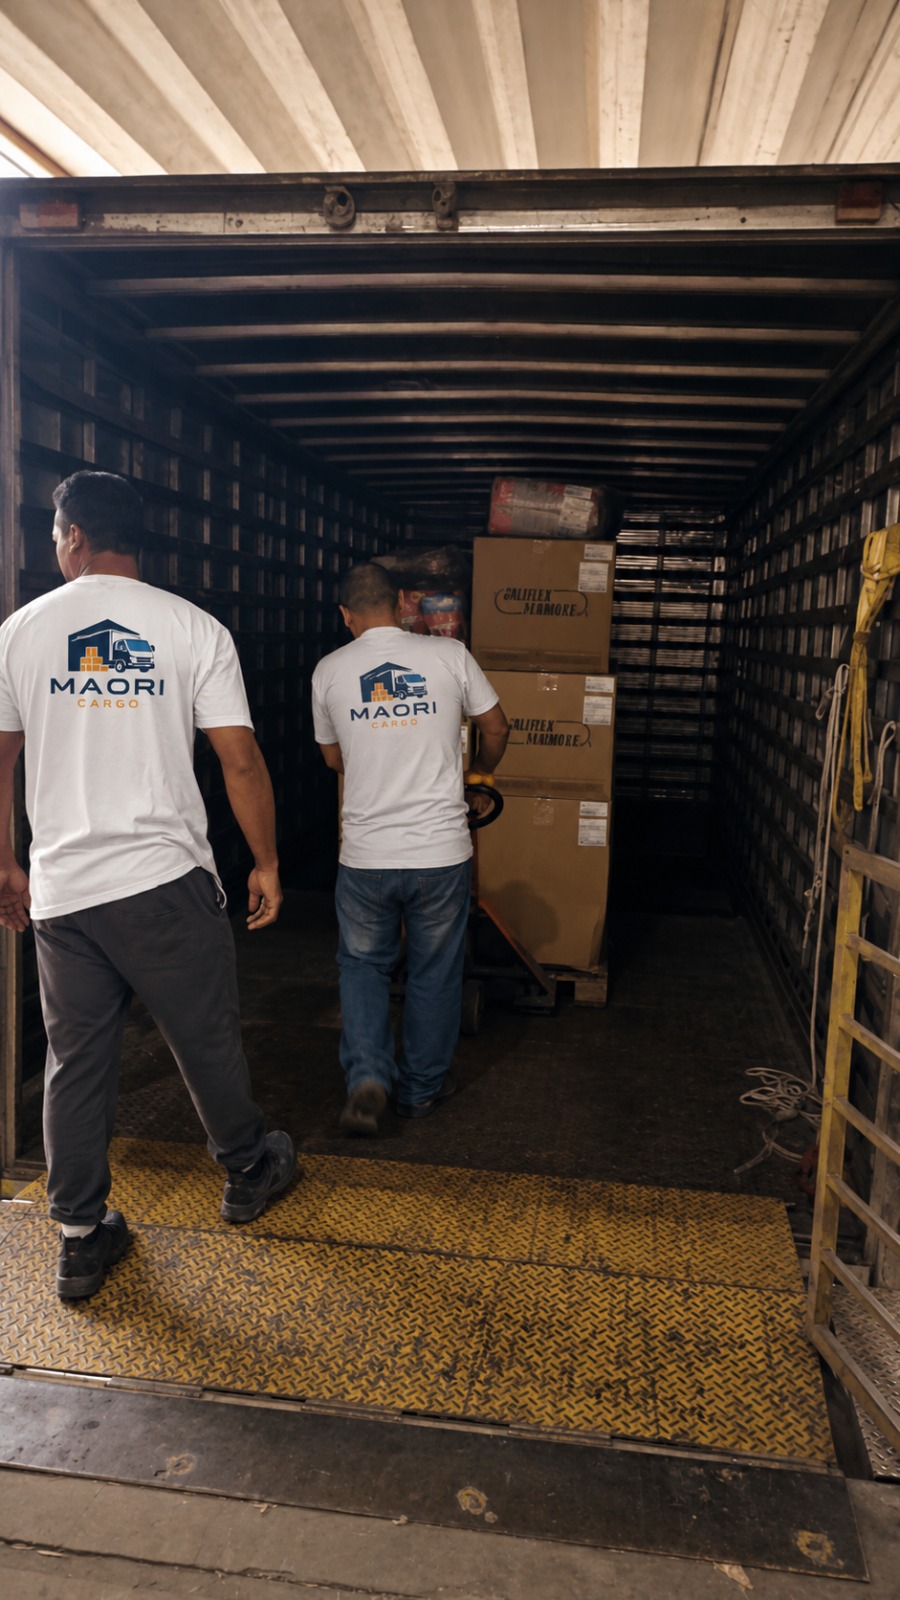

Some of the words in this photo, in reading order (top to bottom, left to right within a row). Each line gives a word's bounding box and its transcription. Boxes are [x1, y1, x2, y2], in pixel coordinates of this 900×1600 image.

[50, 678, 164, 695] MAORI
[77, 699, 139, 708] CARGO
[350, 701, 436, 721] MAORI
[371, 718, 418, 729] CARGO
